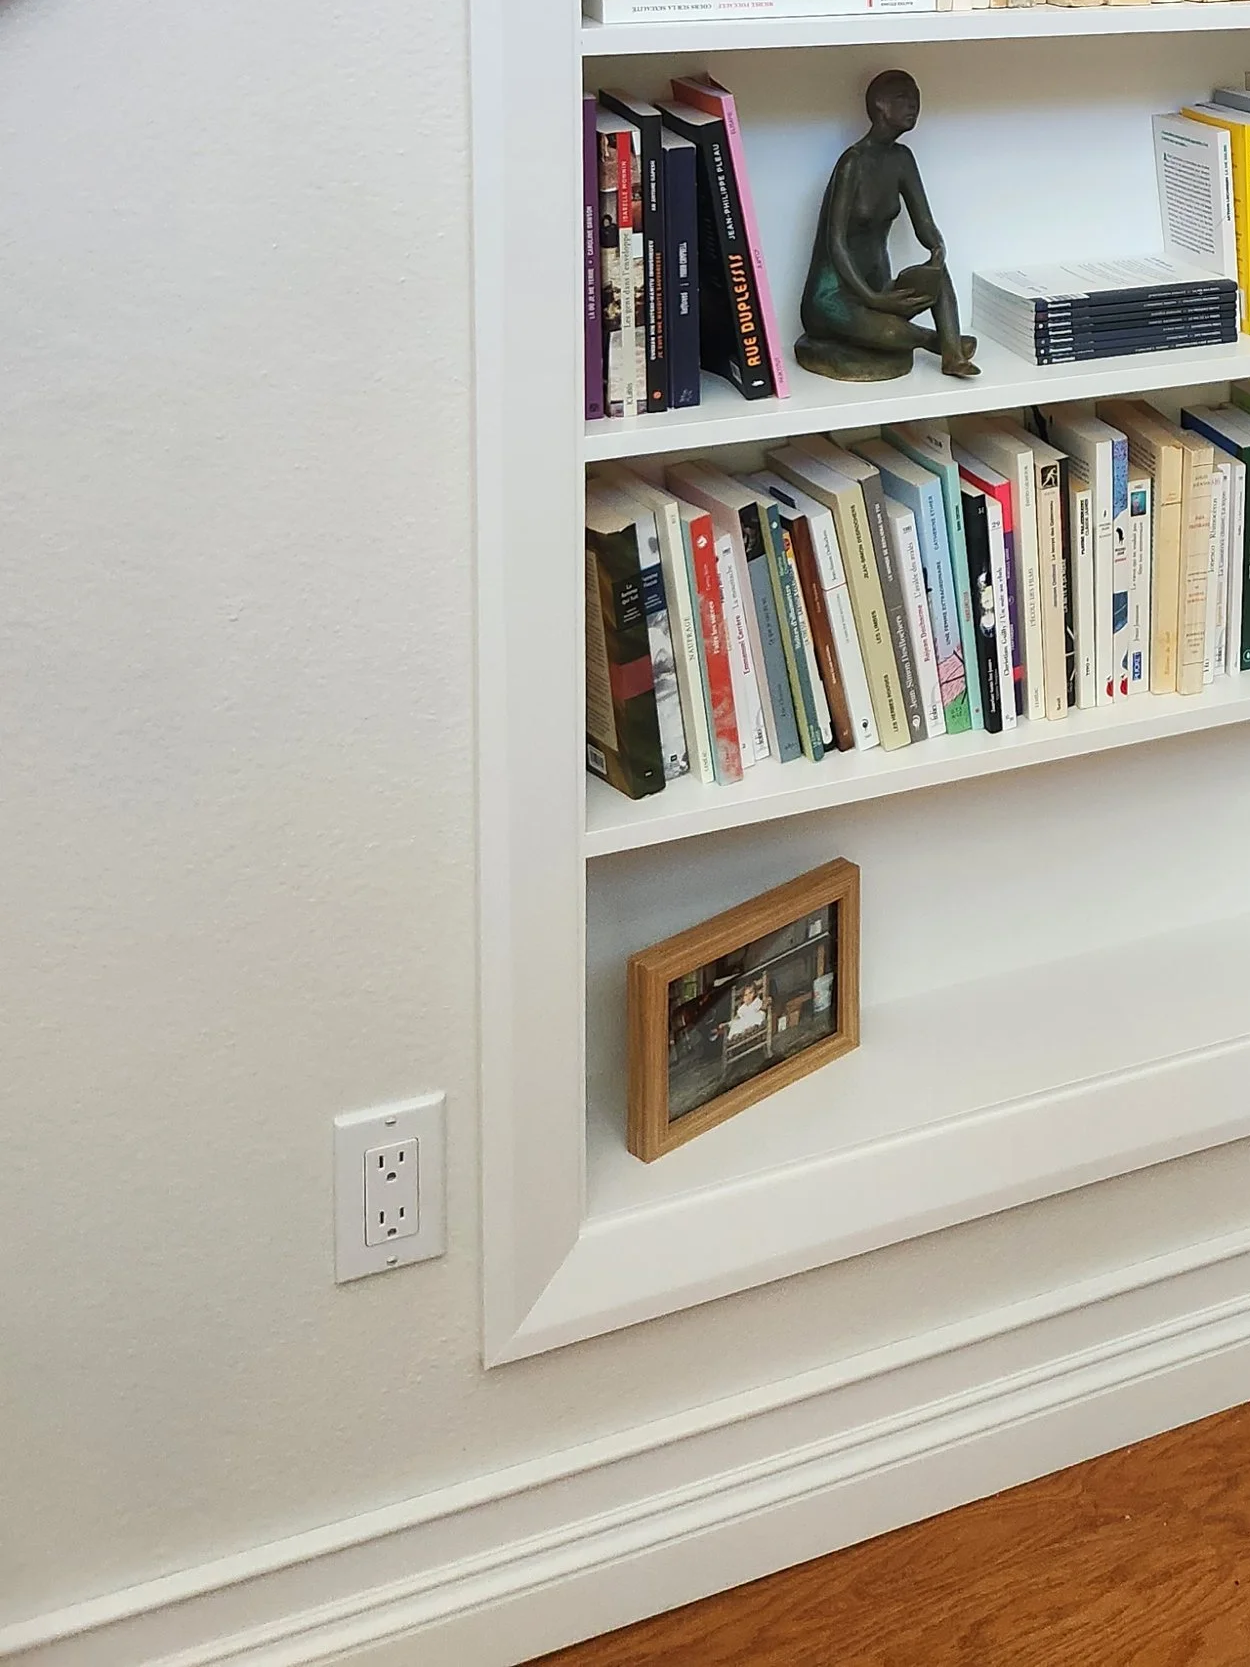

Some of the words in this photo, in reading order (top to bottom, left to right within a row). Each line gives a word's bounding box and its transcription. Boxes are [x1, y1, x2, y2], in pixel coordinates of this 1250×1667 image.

[620, 159, 628, 189] MONNIN
[711, 142, 725, 173] PLEAU
[621, 190, 629, 223] ISABELLE
[717, 174, 737, 240] JEAN-PHILIPPE
[621, 232, 632, 276] l'enveloppe
[622, 278, 632, 297] dans
[727, 253, 755, 333] DUPLESSIS
[623, 297, 634, 317] gens
[744, 336, 762, 367] RUE
[927, 495, 936, 517] ETHIER
[931, 517, 940, 551] CATHERINE
[726, 563, 739, 599] moustache
[936, 561, 948, 611] EXTRAORDINAIRE
[733, 614, 746, 640] Carrère
[941, 611, 950, 632] FEMME
[683, 616, 696, 662] NAUFRAGE
[944, 632, 952, 646] UNE
[737, 639, 751, 676] Emmanuel
[899, 663, 920, 711] Jean-Simon
